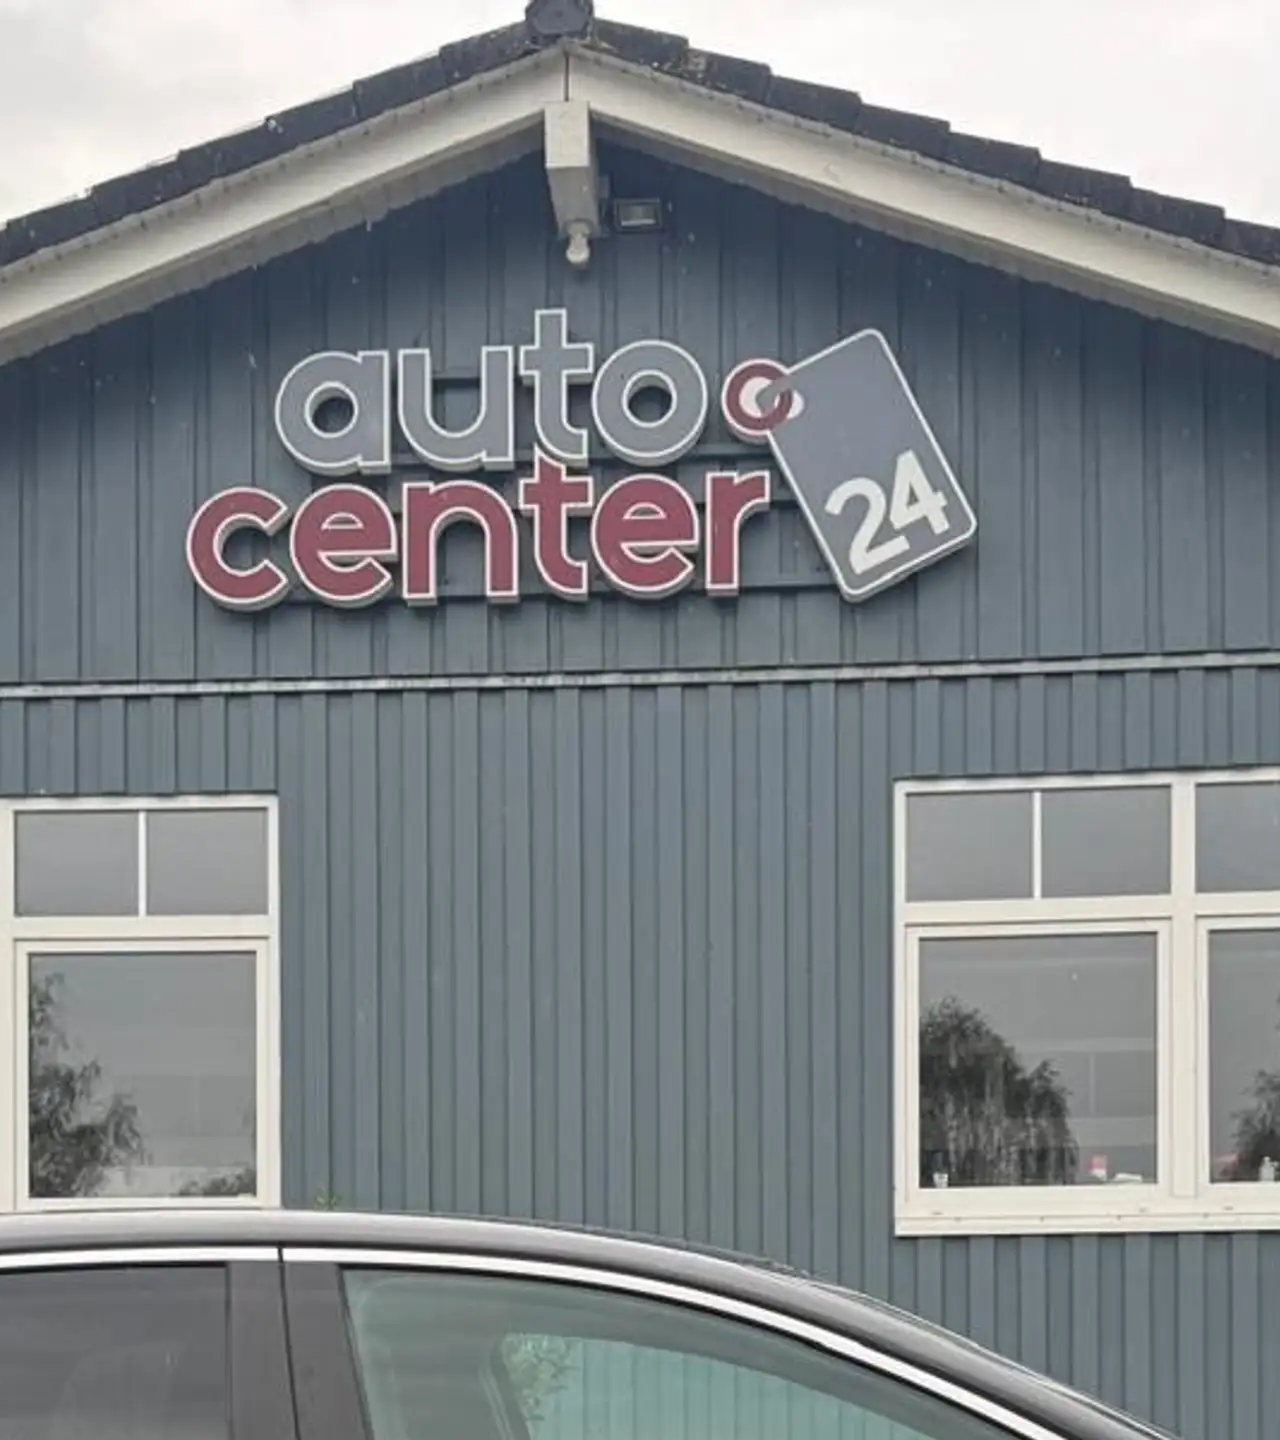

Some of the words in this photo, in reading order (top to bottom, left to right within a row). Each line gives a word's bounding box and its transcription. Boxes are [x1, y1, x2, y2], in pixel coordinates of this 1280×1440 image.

[274, 308, 709, 474] auto
[186, 445, 771, 609] center
[825, 449, 951, 576] 24
